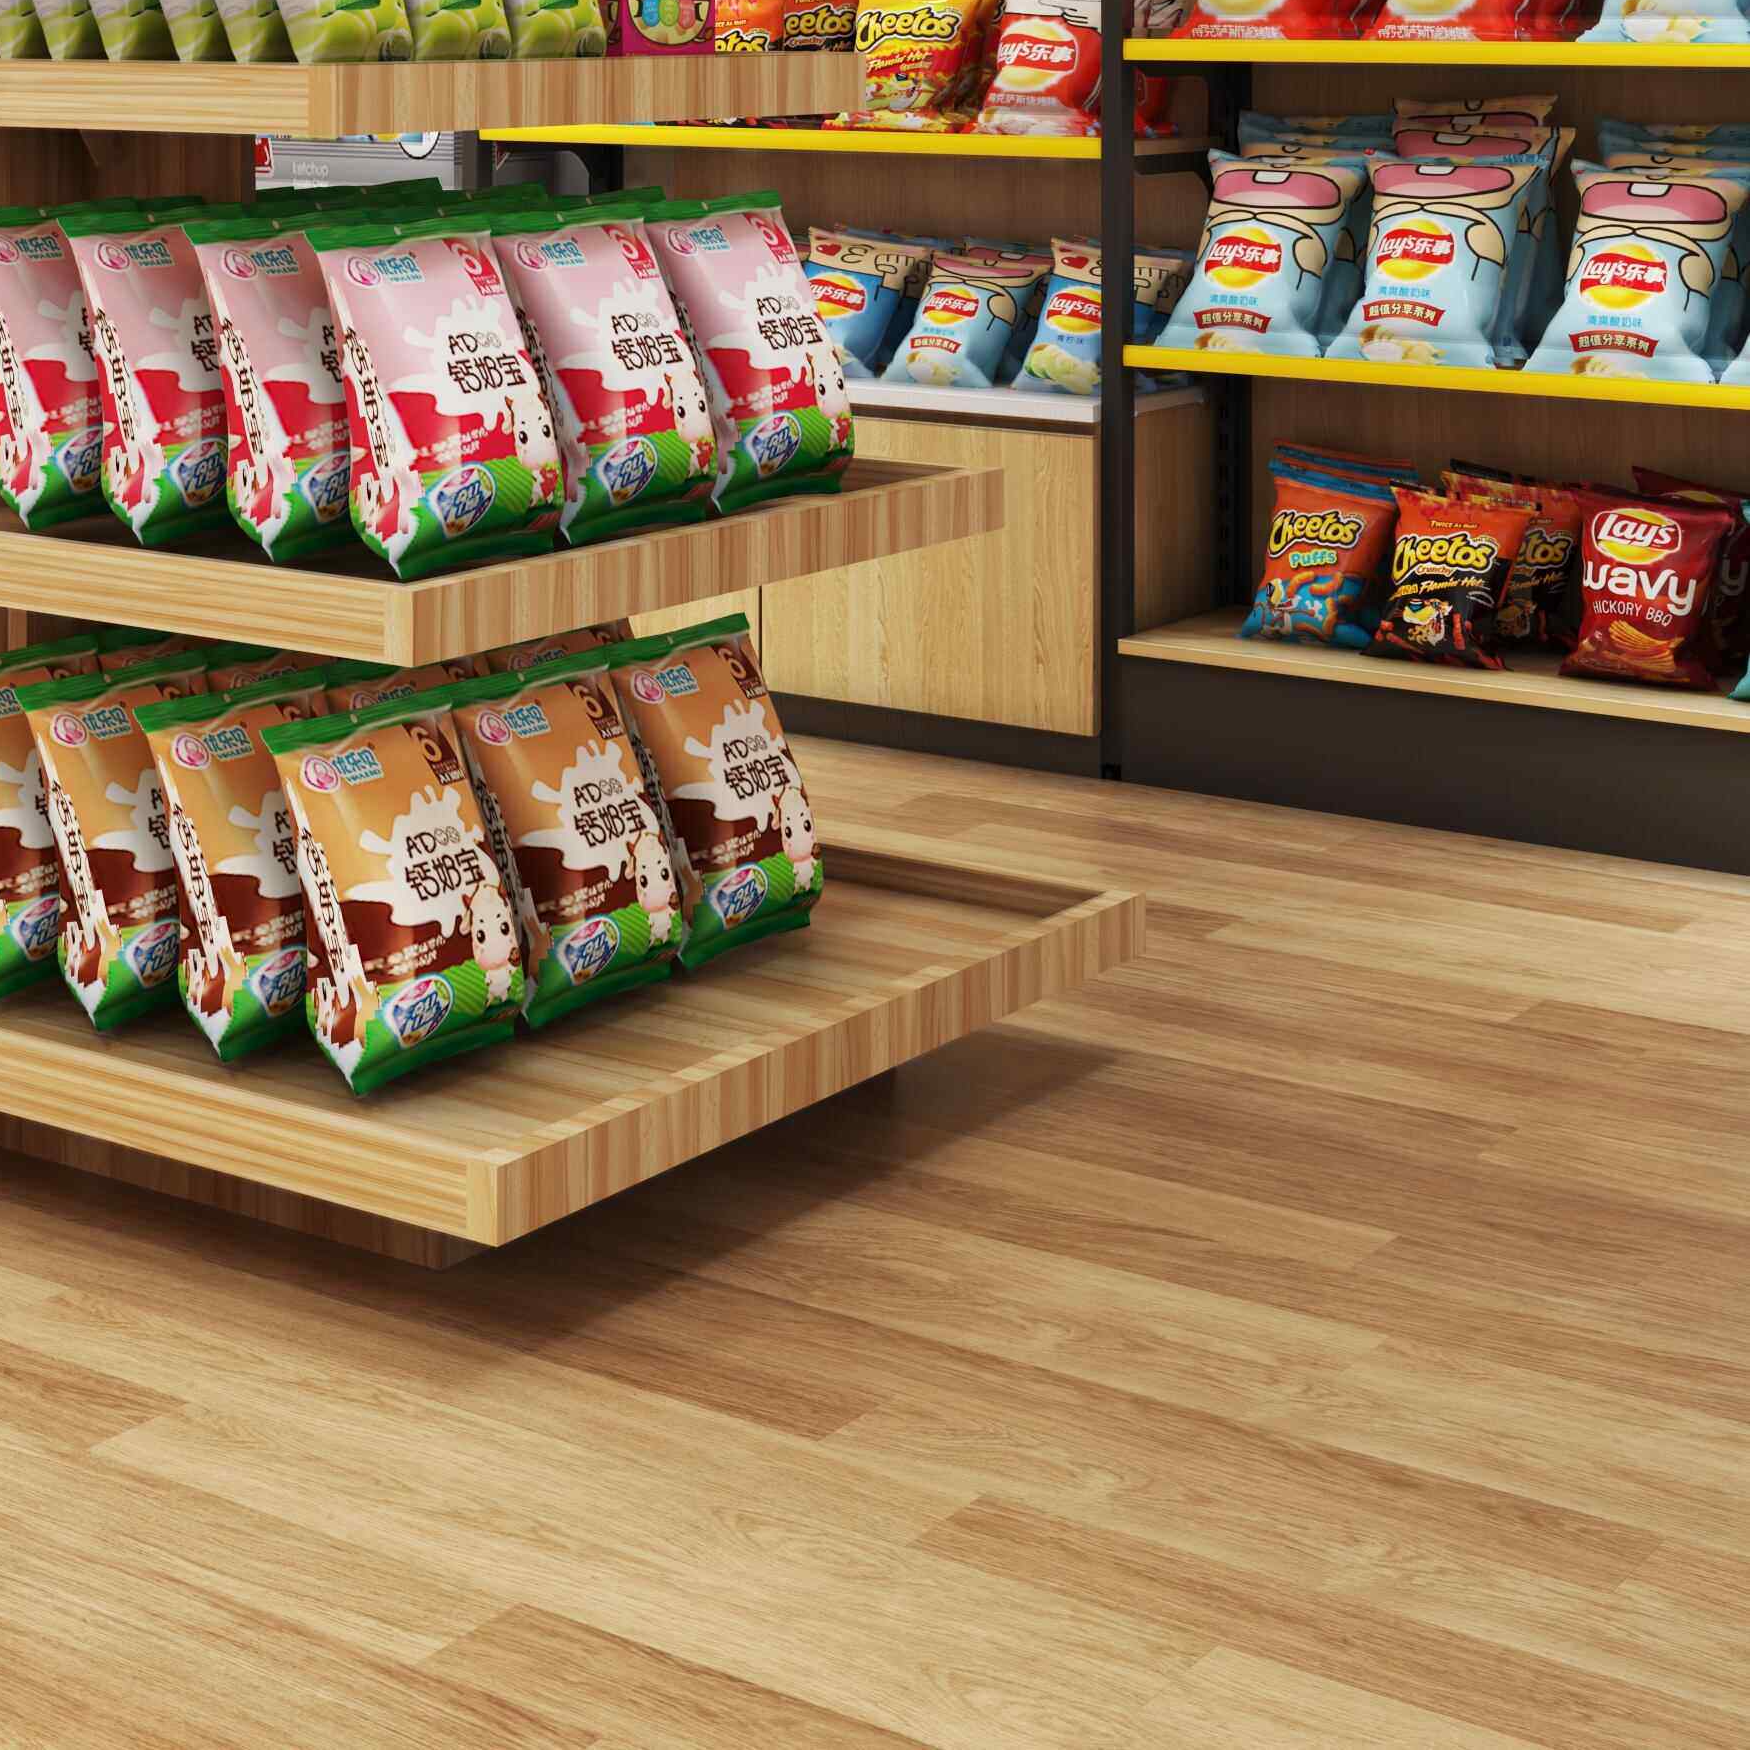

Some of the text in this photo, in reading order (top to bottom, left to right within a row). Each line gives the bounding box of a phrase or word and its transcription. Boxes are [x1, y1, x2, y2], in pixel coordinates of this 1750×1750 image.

[785, 6, 853, 38] eetos
[856, 6, 960, 53] Cheetos
[810, 281, 865, 305] ay's乐事
[611, 332, 685, 372] 钙奶宝
[759, 313, 824, 351] 钙奶宝
[447, 353, 527, 395] 钙奶宝
[1268, 511, 1358, 557] Cheetos
[1596, 512, 1676, 550] Lay's
[1289, 549, 1337, 568] Puffs
[1392, 533, 1494, 583] Cheetos
[1582, 561, 1697, 617] wavy
[1592, 598, 1674, 627] HICKORY BBQ
[331, 748, 379, 774] 优乐贝
[723, 755, 790, 801] 钙奶宝
[573, 799, 648, 849] 钙奶宝
[405, 848, 486, 903] 钙奶宝
